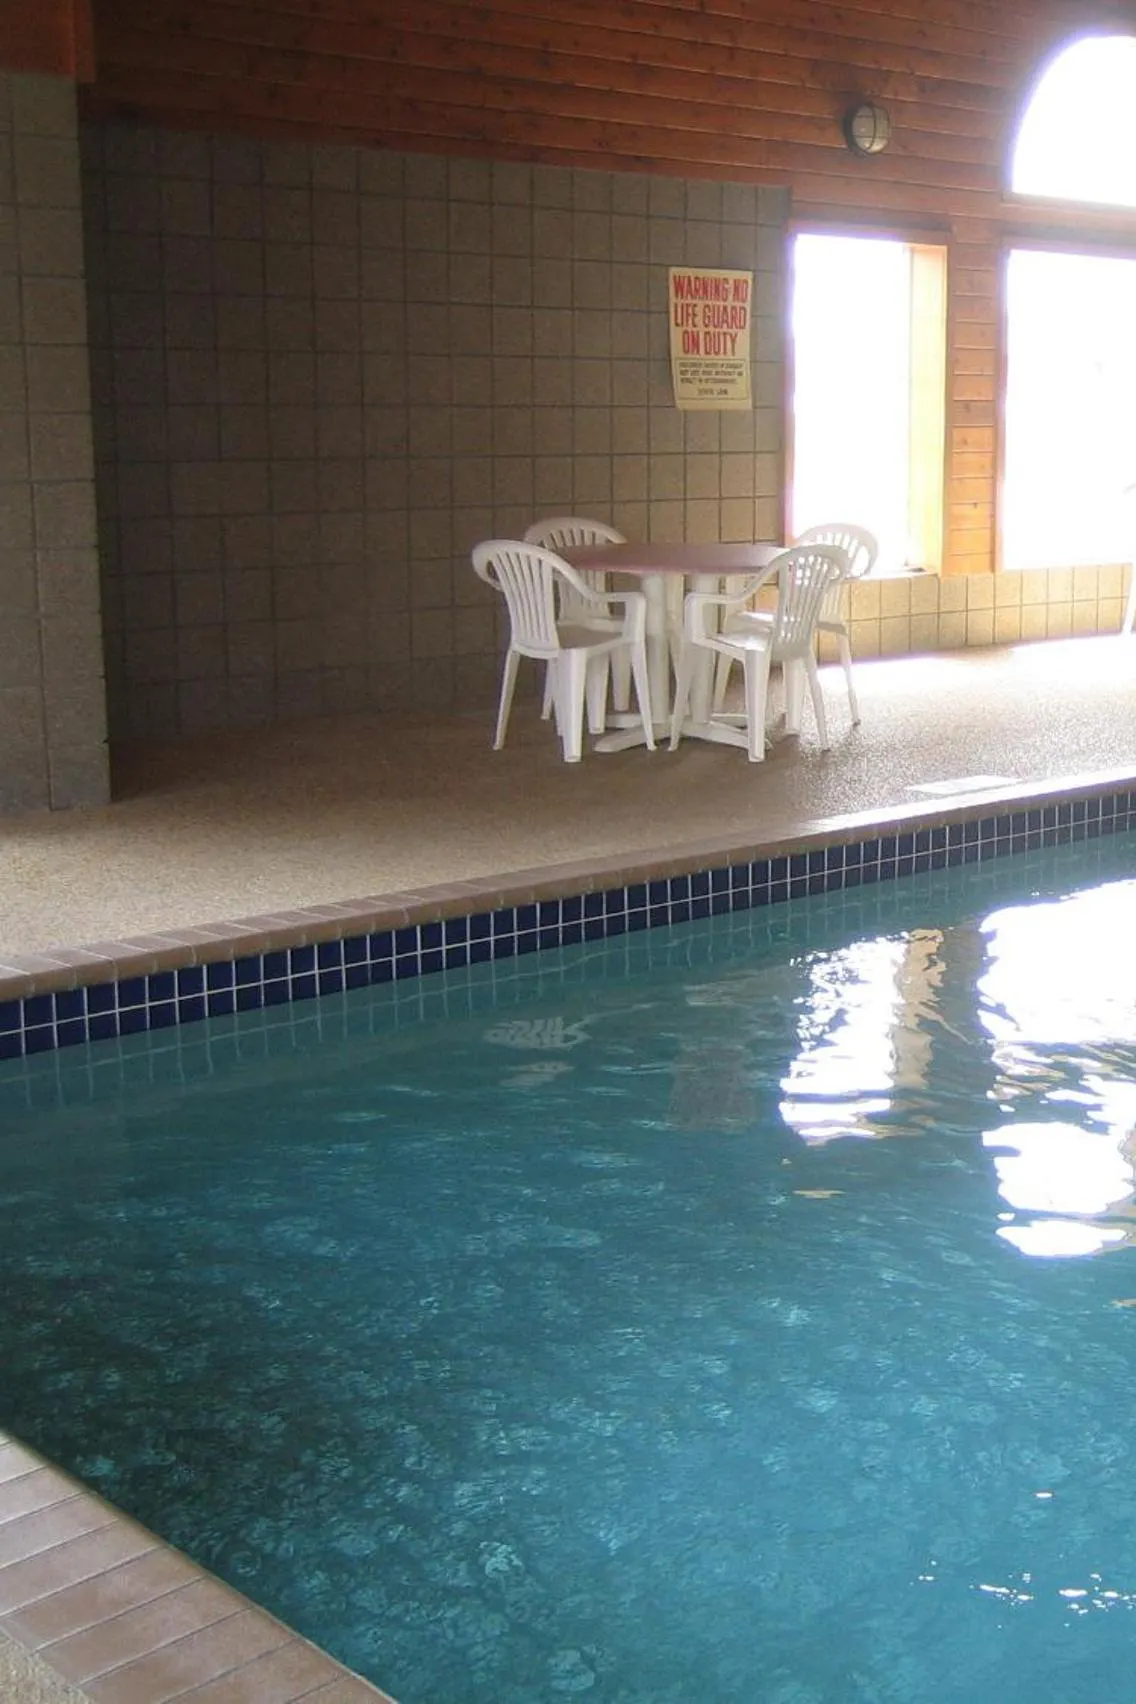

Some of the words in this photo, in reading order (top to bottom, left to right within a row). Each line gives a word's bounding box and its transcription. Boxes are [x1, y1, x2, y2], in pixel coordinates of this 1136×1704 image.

[673, 275, 729, 302] WARNING
[732, 279, 749, 304] NO
[674, 302, 698, 328] LIFE
[702, 305, 747, 330] GUARD
[682, 330, 701, 356] ON
[704, 331, 739, 357] DUTY
